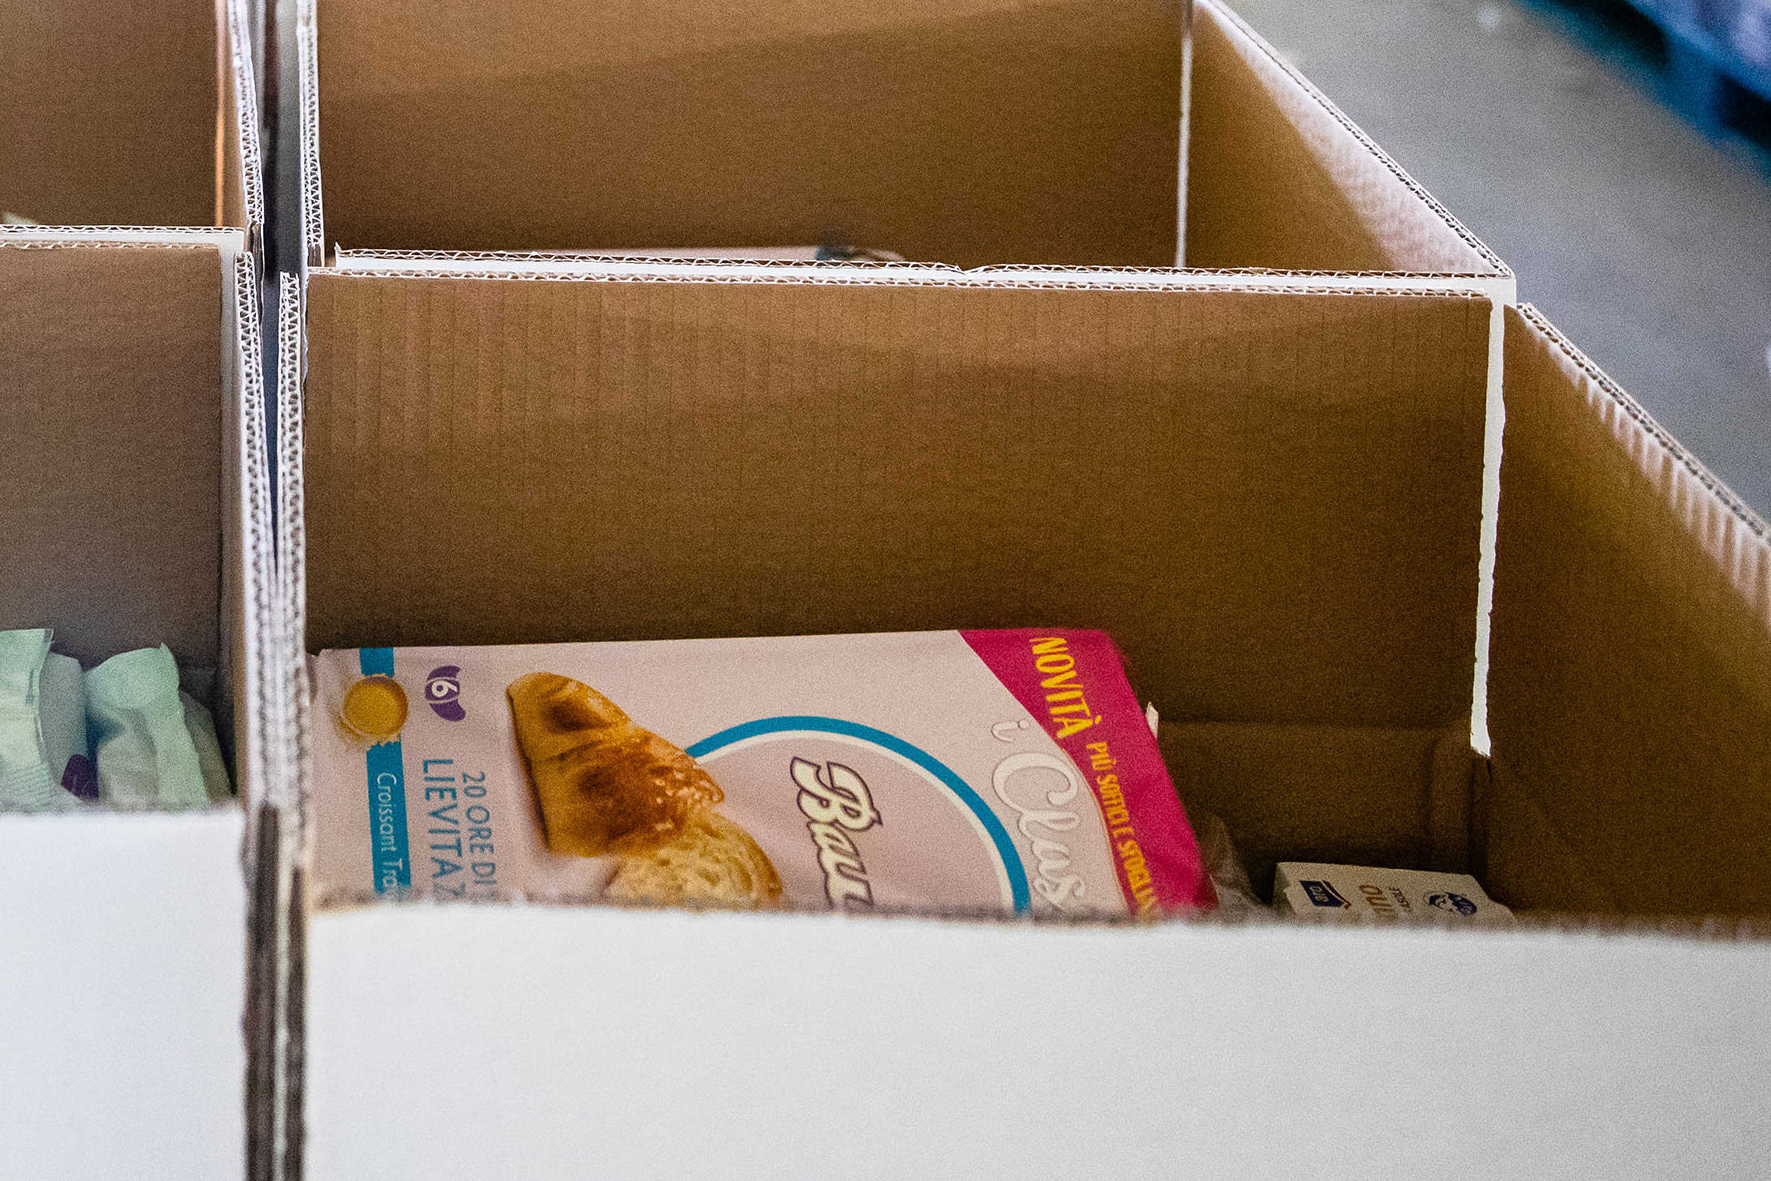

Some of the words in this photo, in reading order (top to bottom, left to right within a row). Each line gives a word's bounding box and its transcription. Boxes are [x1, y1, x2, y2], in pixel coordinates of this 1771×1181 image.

[431, 680, 458, 697] 6
[1029, 636, 1102, 739] NOVITÀ
[1086, 741, 1117, 771] PIÙ
[462, 771, 488, 799] 20
[1096, 774, 1130, 825] SOFFICI
[377, 773, 397, 852] Croissant
[423, 759, 466, 898] LIEVITAZ
[466, 805, 494, 855] ORE
[790, 756, 884, 909] Bau
[991, 752, 1086, 909] Clas
[1113, 826, 1135, 839] E
[382, 858, 403, 888] Tra
[471, 861, 497, 885] DI
